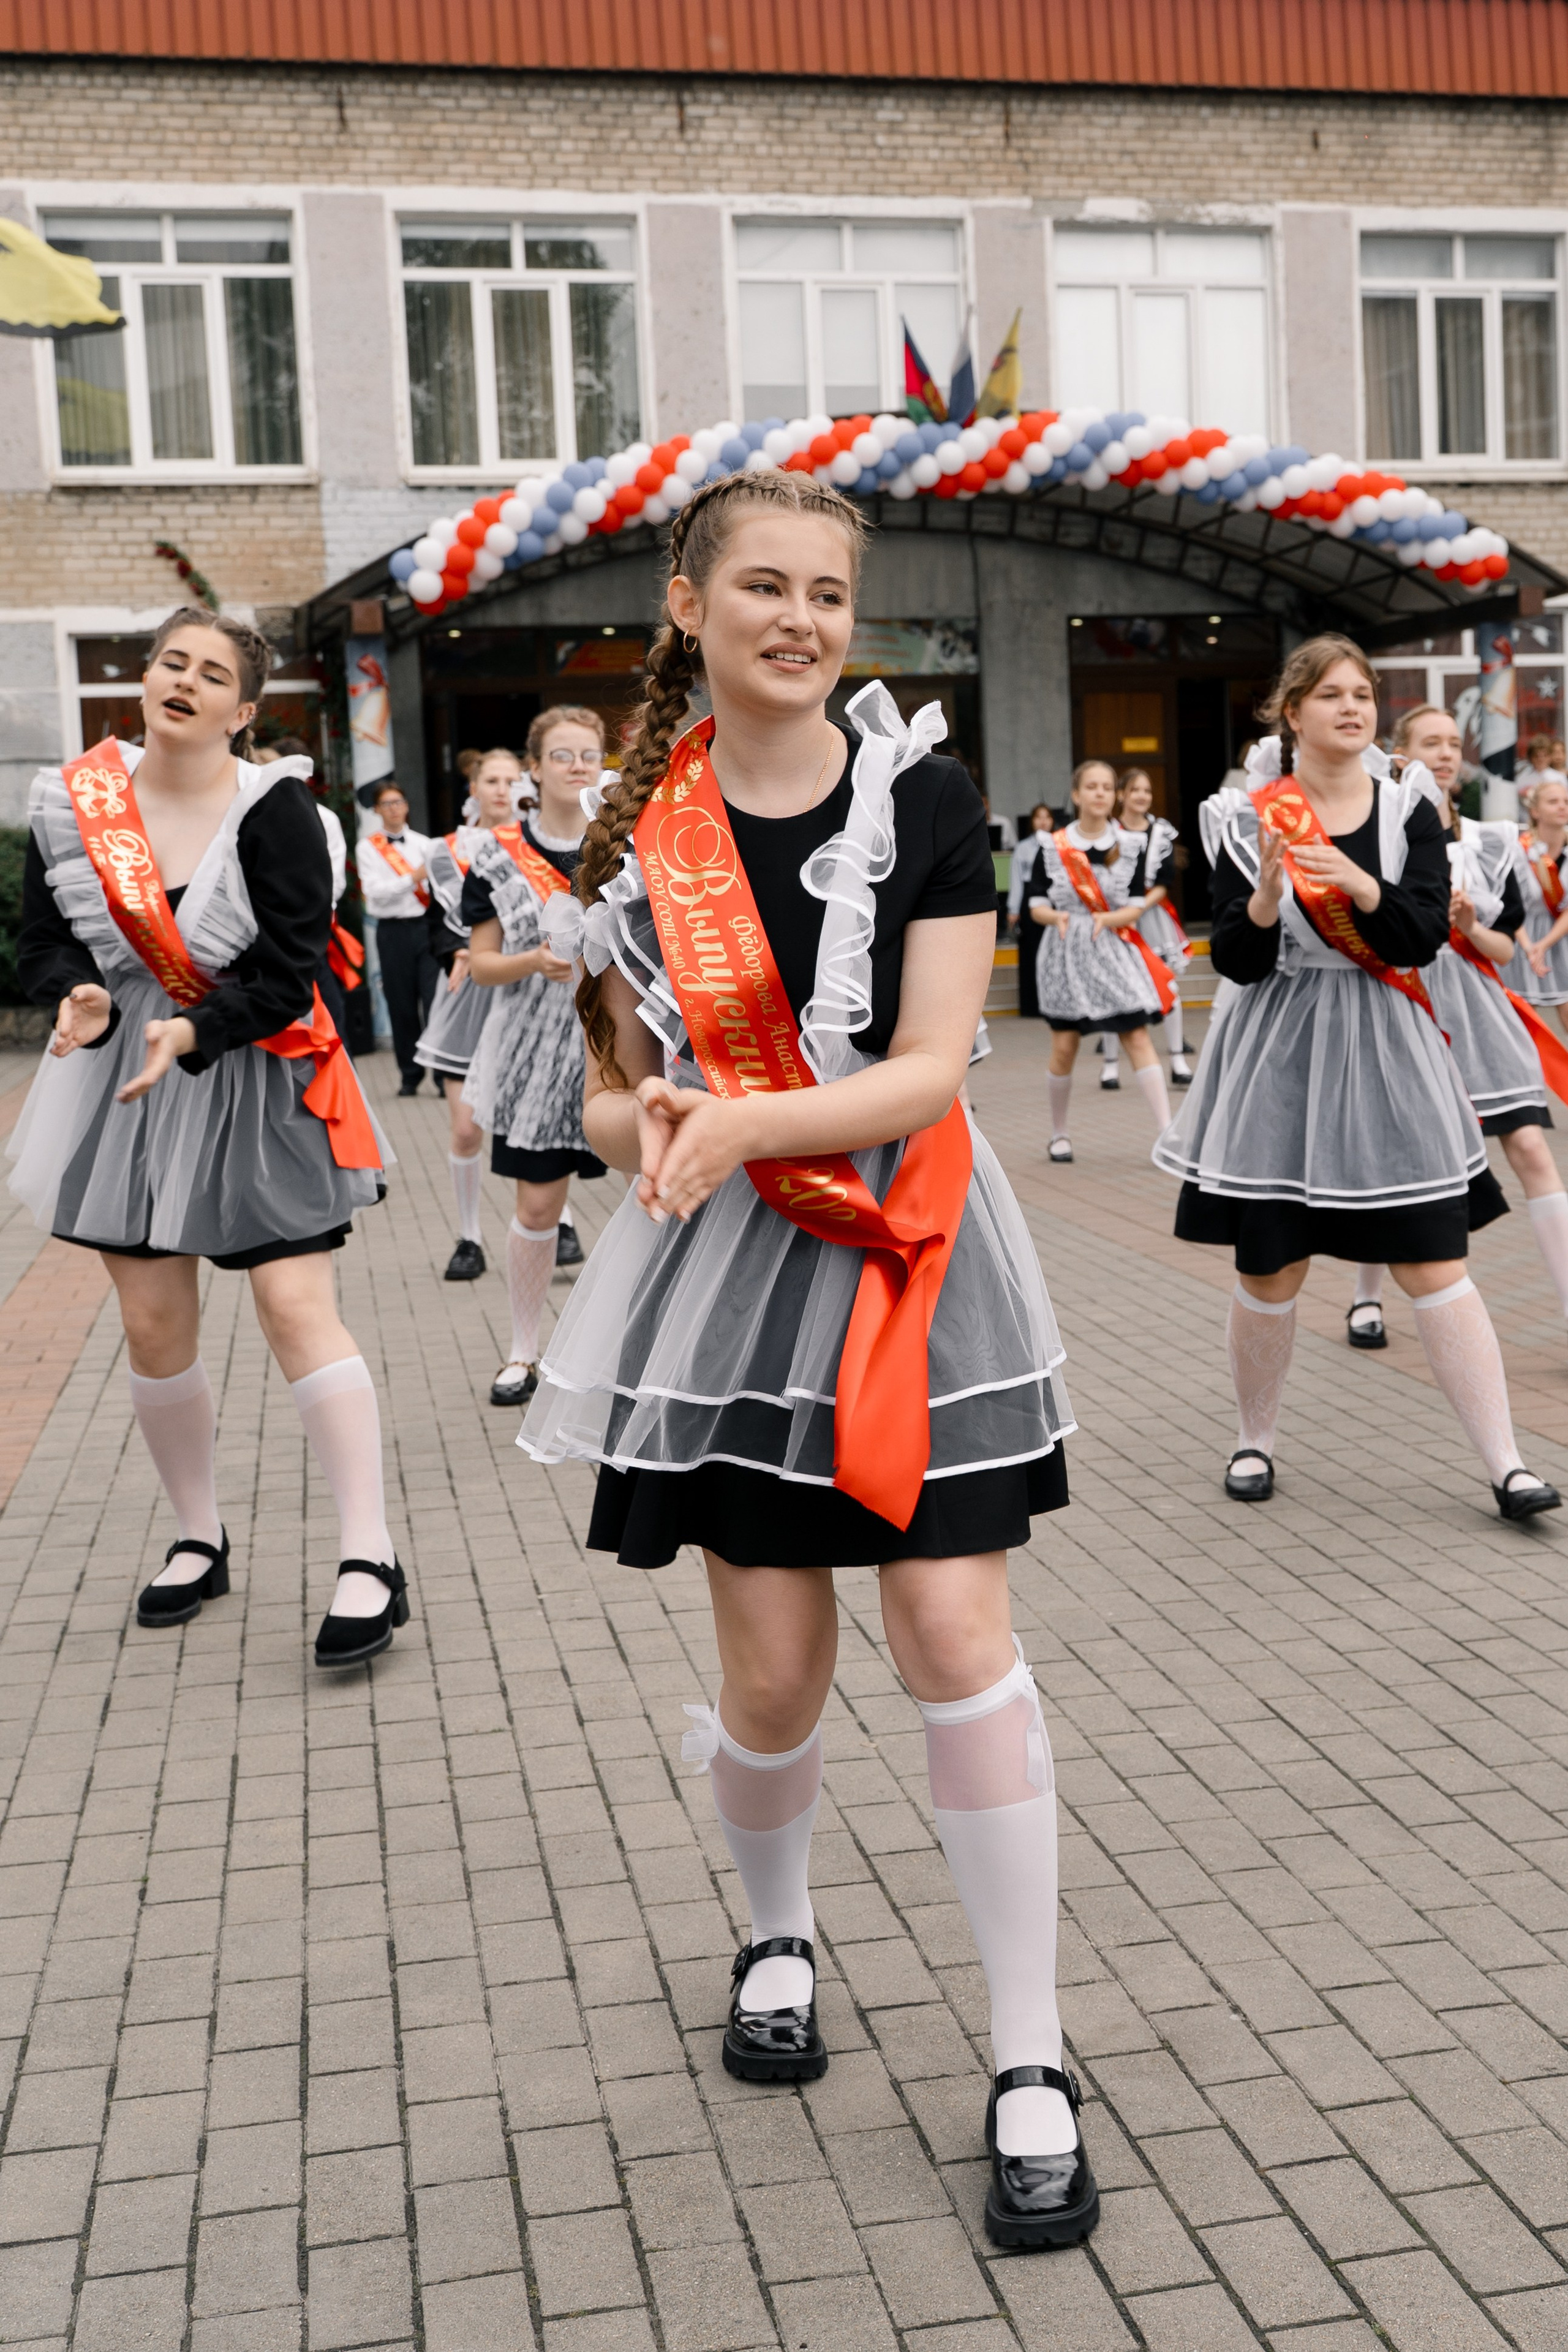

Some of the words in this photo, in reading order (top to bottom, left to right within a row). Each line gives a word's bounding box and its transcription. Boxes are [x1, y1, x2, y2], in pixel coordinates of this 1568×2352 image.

[643, 851, 669, 902] МАОУ
[655, 902, 679, 939] СОШ
[657, 806, 777, 1098] Выпускни
[665, 940, 686, 969] №40
[684, 998, 695, 1008] г.
[728, 915, 777, 1016] Фёдорова
[763, 1019, 804, 1091] Анаст
[688, 1009, 730, 1099] Новороссийск
